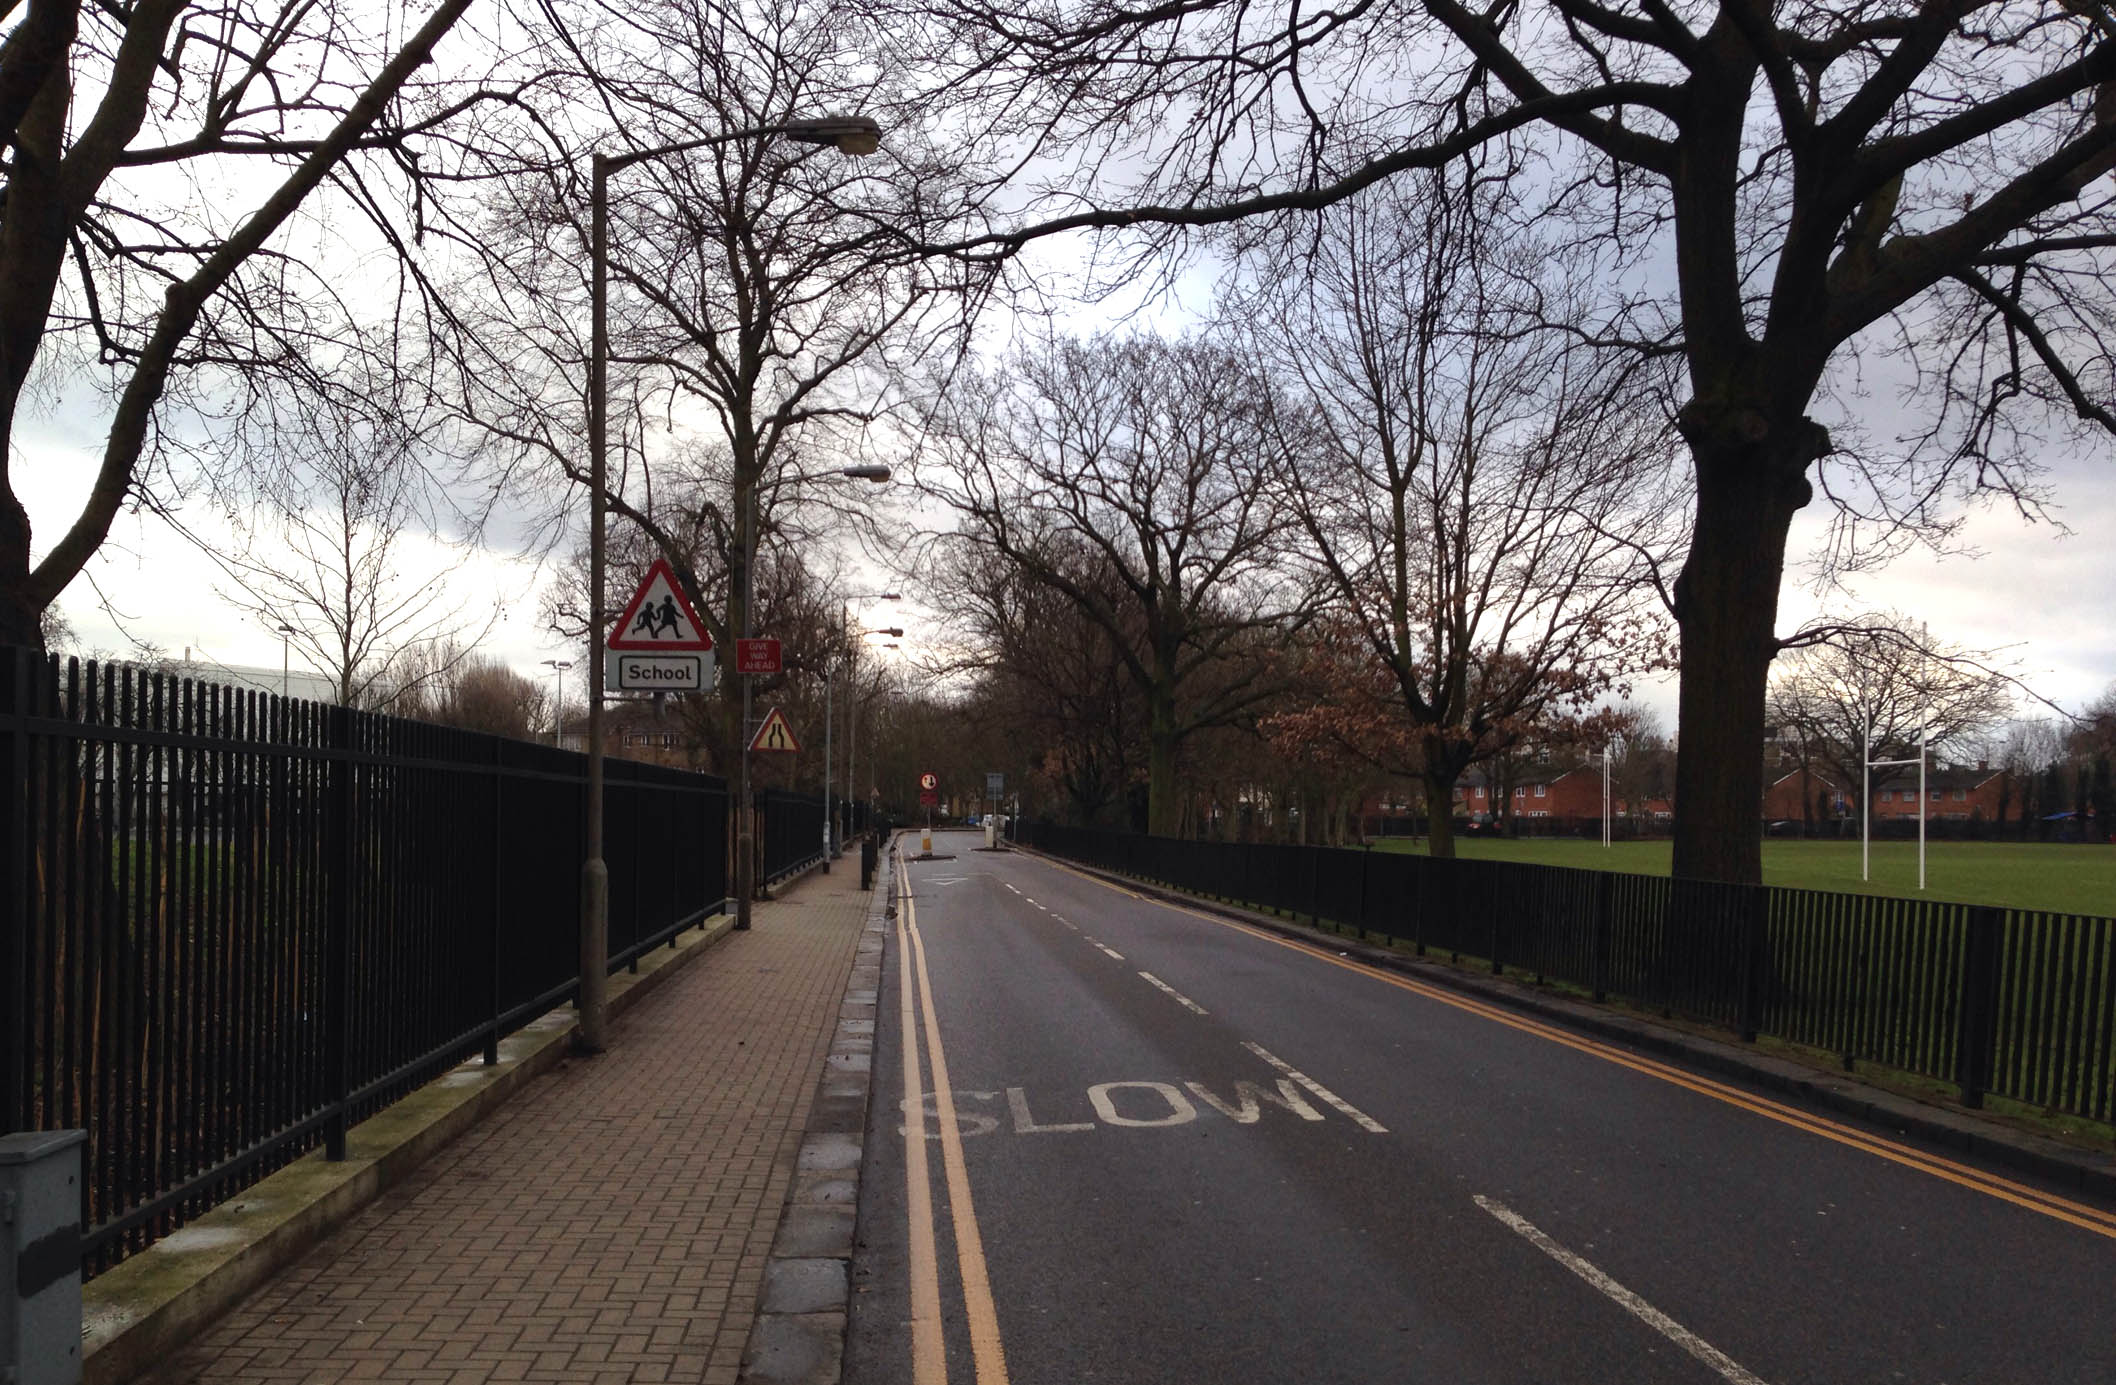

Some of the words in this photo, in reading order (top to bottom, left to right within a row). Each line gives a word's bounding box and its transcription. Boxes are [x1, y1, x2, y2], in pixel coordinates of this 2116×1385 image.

[629, 664, 692, 681] School
[744, 660, 776, 670] AHEAD
[898, 1079, 1326, 1140] SLOW
